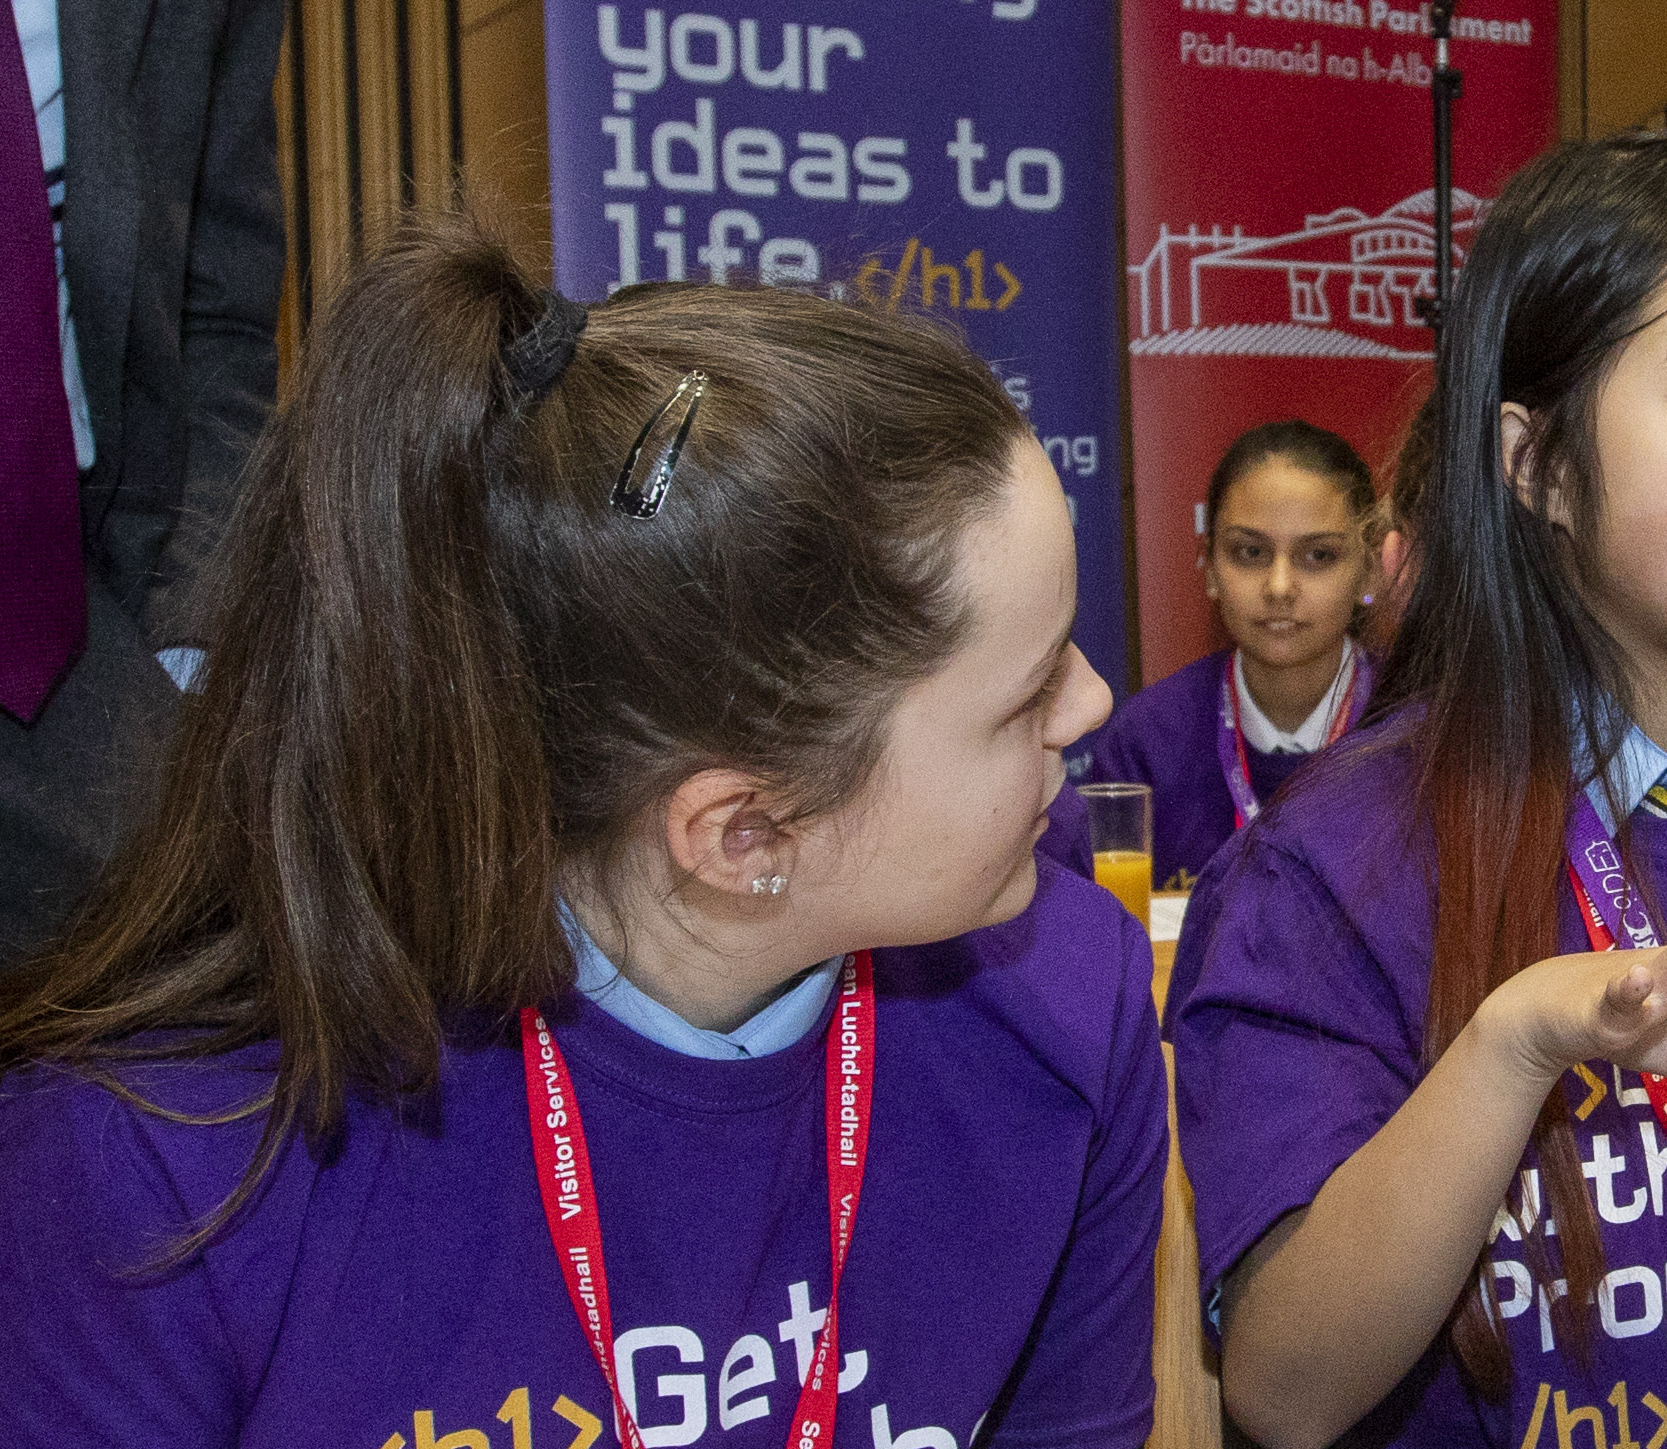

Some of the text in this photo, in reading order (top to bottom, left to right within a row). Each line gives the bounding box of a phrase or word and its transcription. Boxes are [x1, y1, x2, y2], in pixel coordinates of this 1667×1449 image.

[598, 4, 865, 96] your
[1326, 53, 1358, 80] na
[1363, 47, 1433, 88] h-Alb
[602, 94, 1063, 211] ideas to
[534, 1016, 582, 1222] Visitor Services
[840, 1001, 862, 1168] Luchd-tadhail
